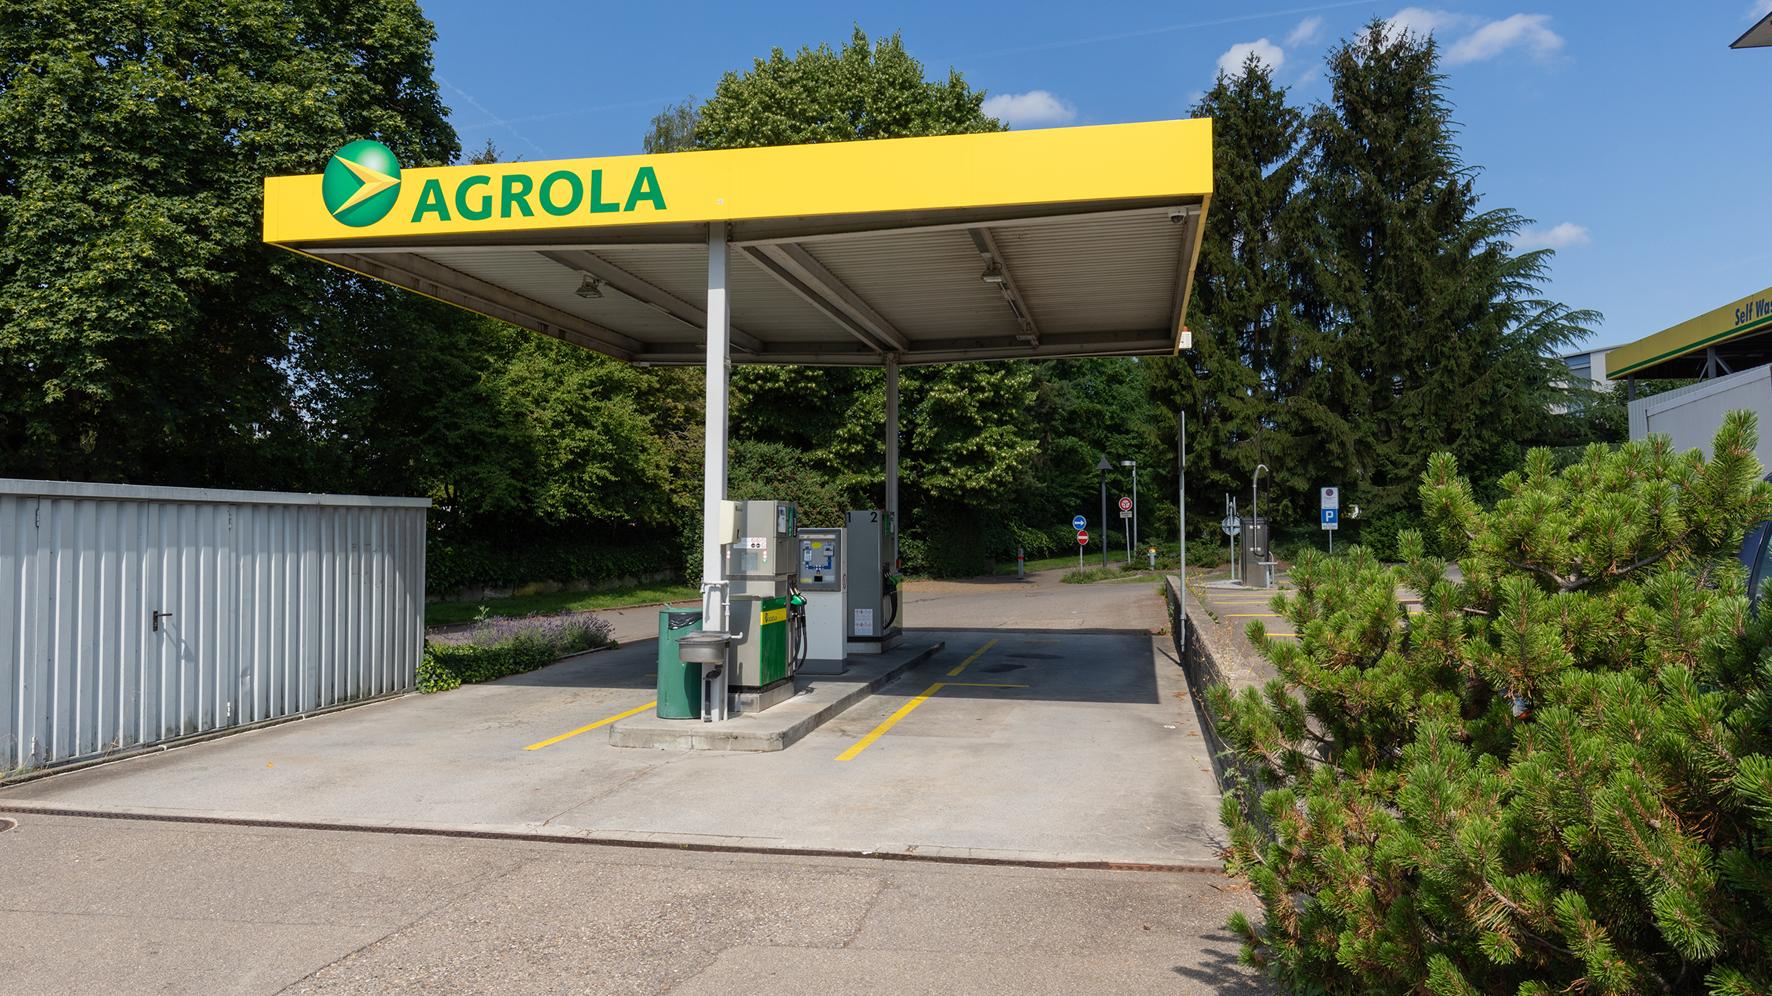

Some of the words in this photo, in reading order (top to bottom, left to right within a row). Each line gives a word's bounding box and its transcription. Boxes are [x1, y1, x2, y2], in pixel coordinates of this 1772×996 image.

[411, 166, 667, 223] AGROLA
[1735, 301, 1753, 326] Self
[847, 511, 852, 523] 1
[870, 511, 878, 523] 2
[1325, 511, 1334, 522] P
